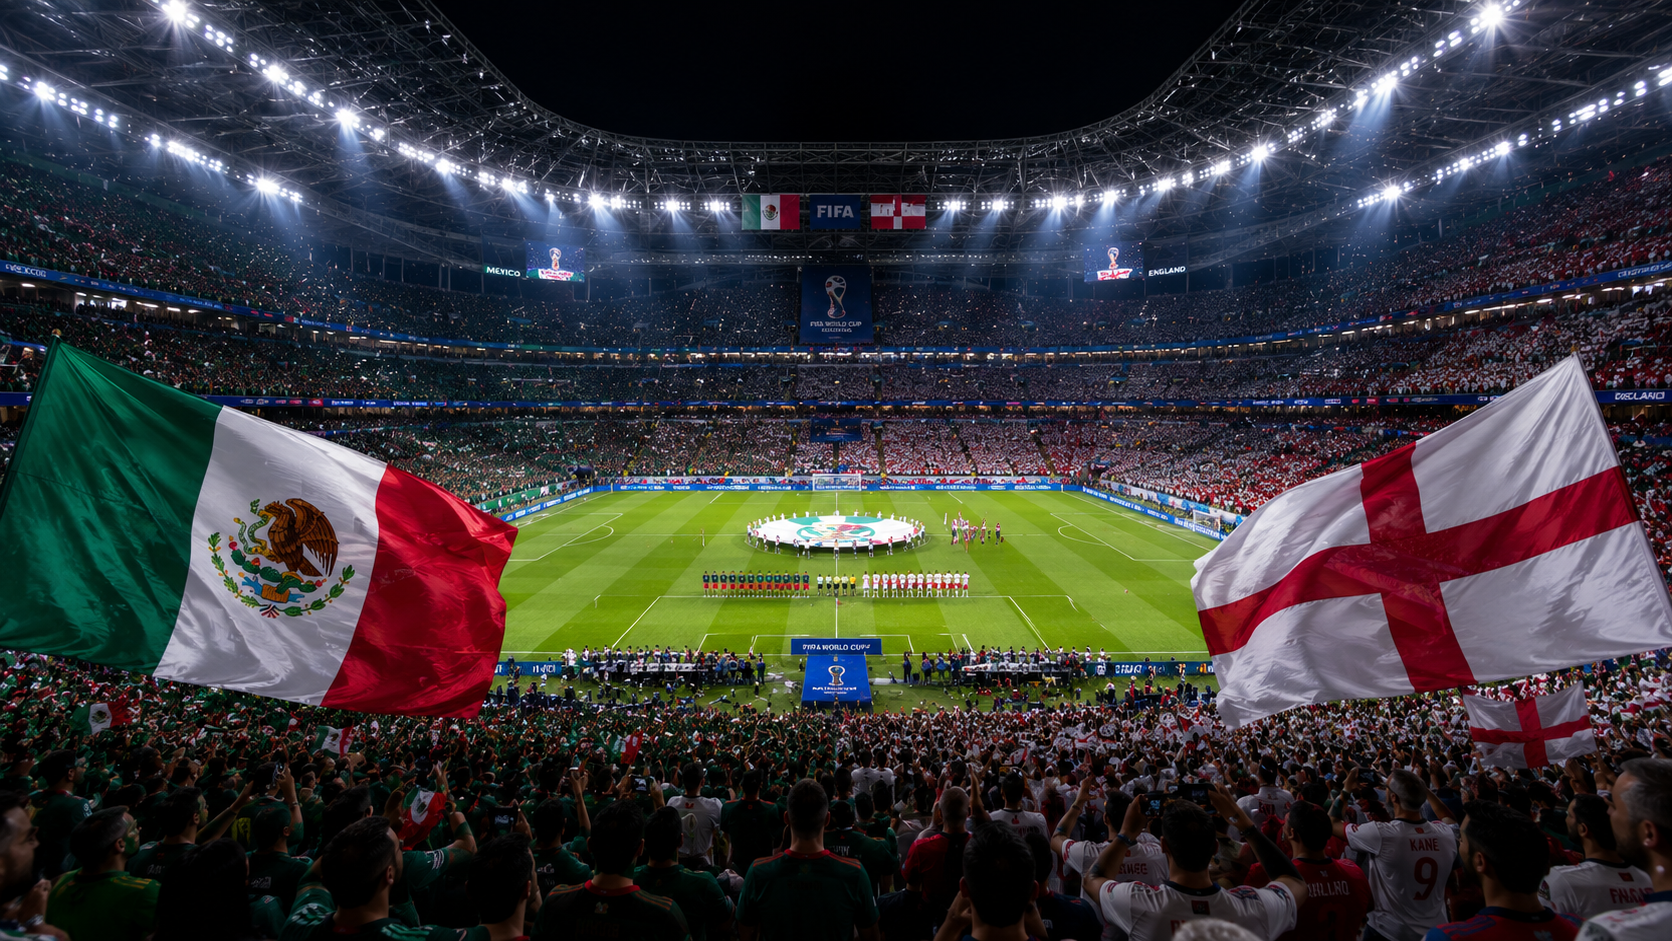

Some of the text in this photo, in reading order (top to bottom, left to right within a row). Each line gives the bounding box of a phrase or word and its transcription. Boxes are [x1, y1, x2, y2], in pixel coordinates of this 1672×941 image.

[817, 205, 854, 218] FIFA
[1148, 266, 1186, 277] ENGLAND
[1409, 838, 1440, 852] KANE
[1413, 856, 1438, 901] 9
